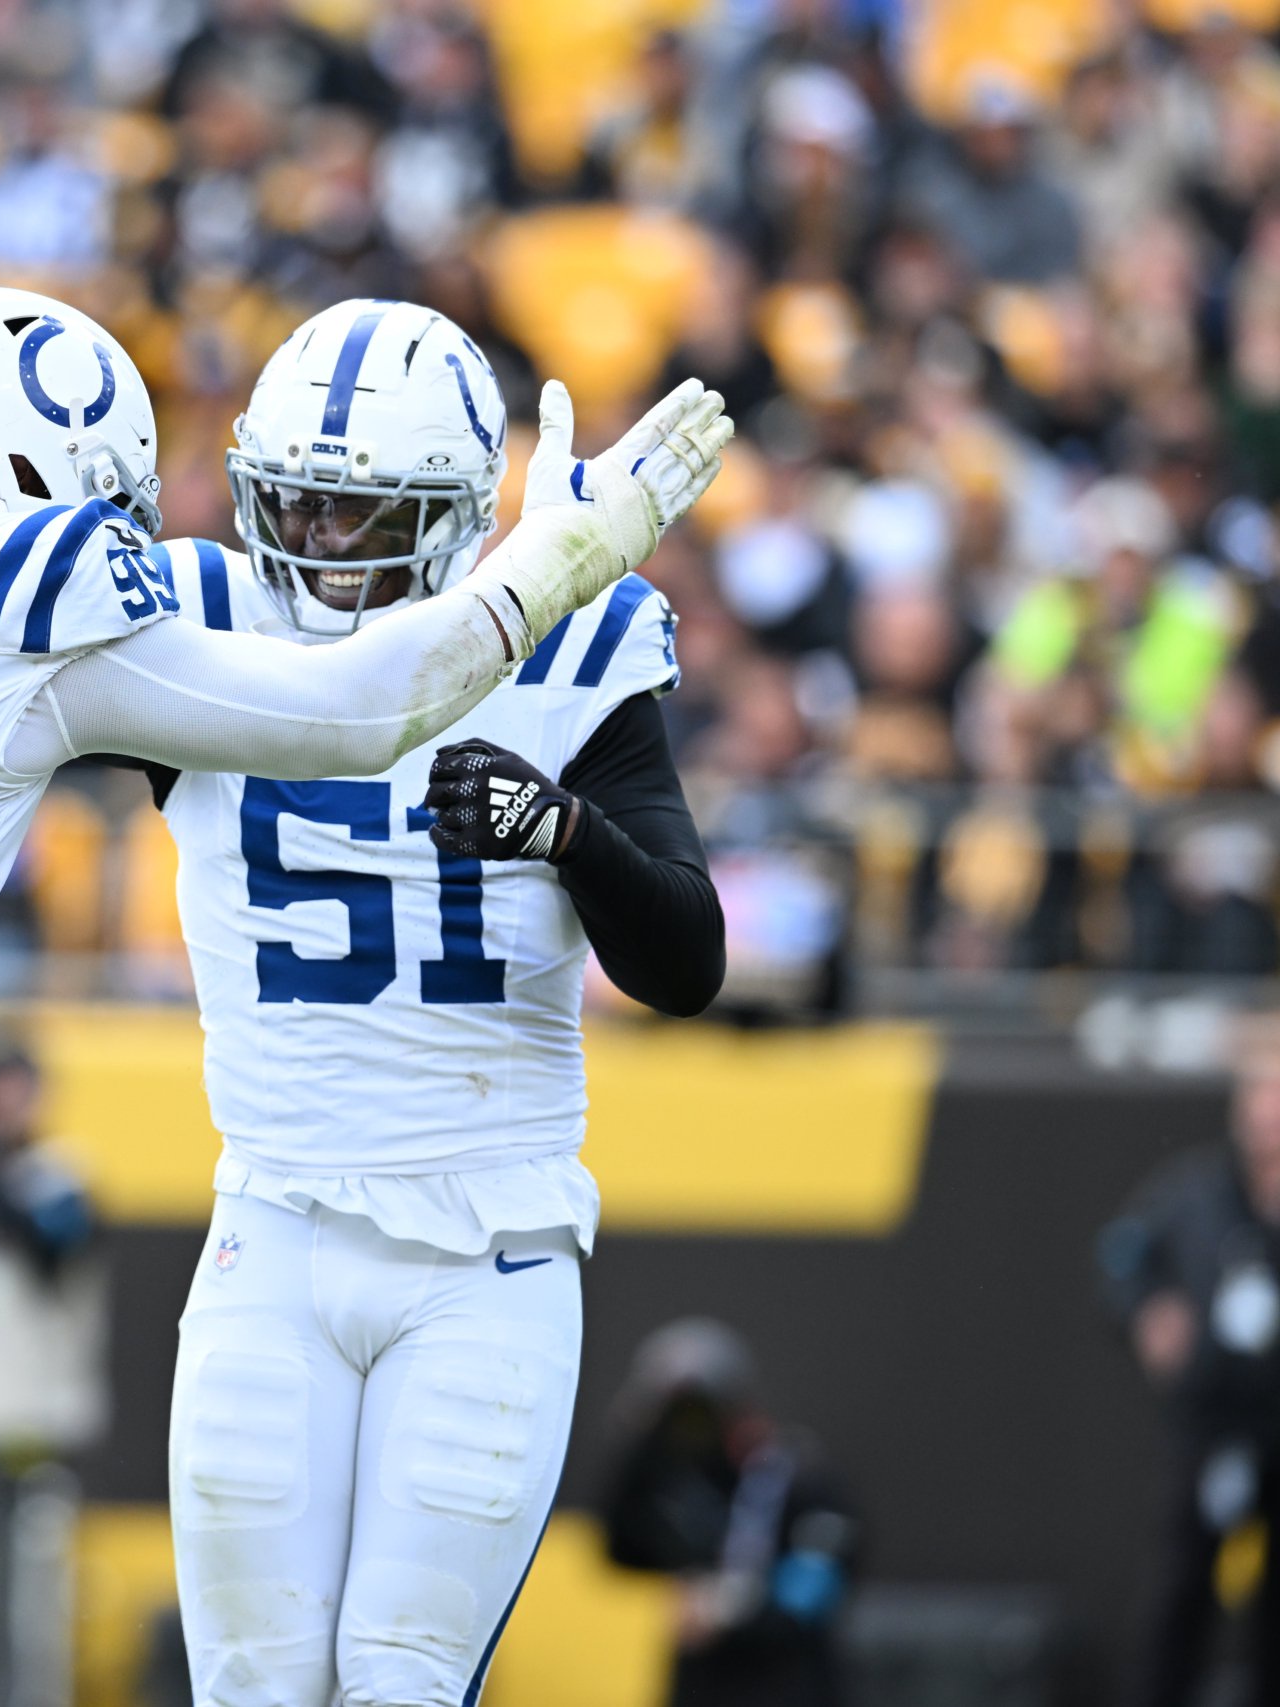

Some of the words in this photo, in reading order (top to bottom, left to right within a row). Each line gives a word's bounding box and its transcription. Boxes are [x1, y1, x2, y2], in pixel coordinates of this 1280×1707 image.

[311, 443, 348, 457] COLTS
[106, 547, 181, 621] 99
[494, 780, 540, 839] adidas
[240, 775, 507, 1005] 51
